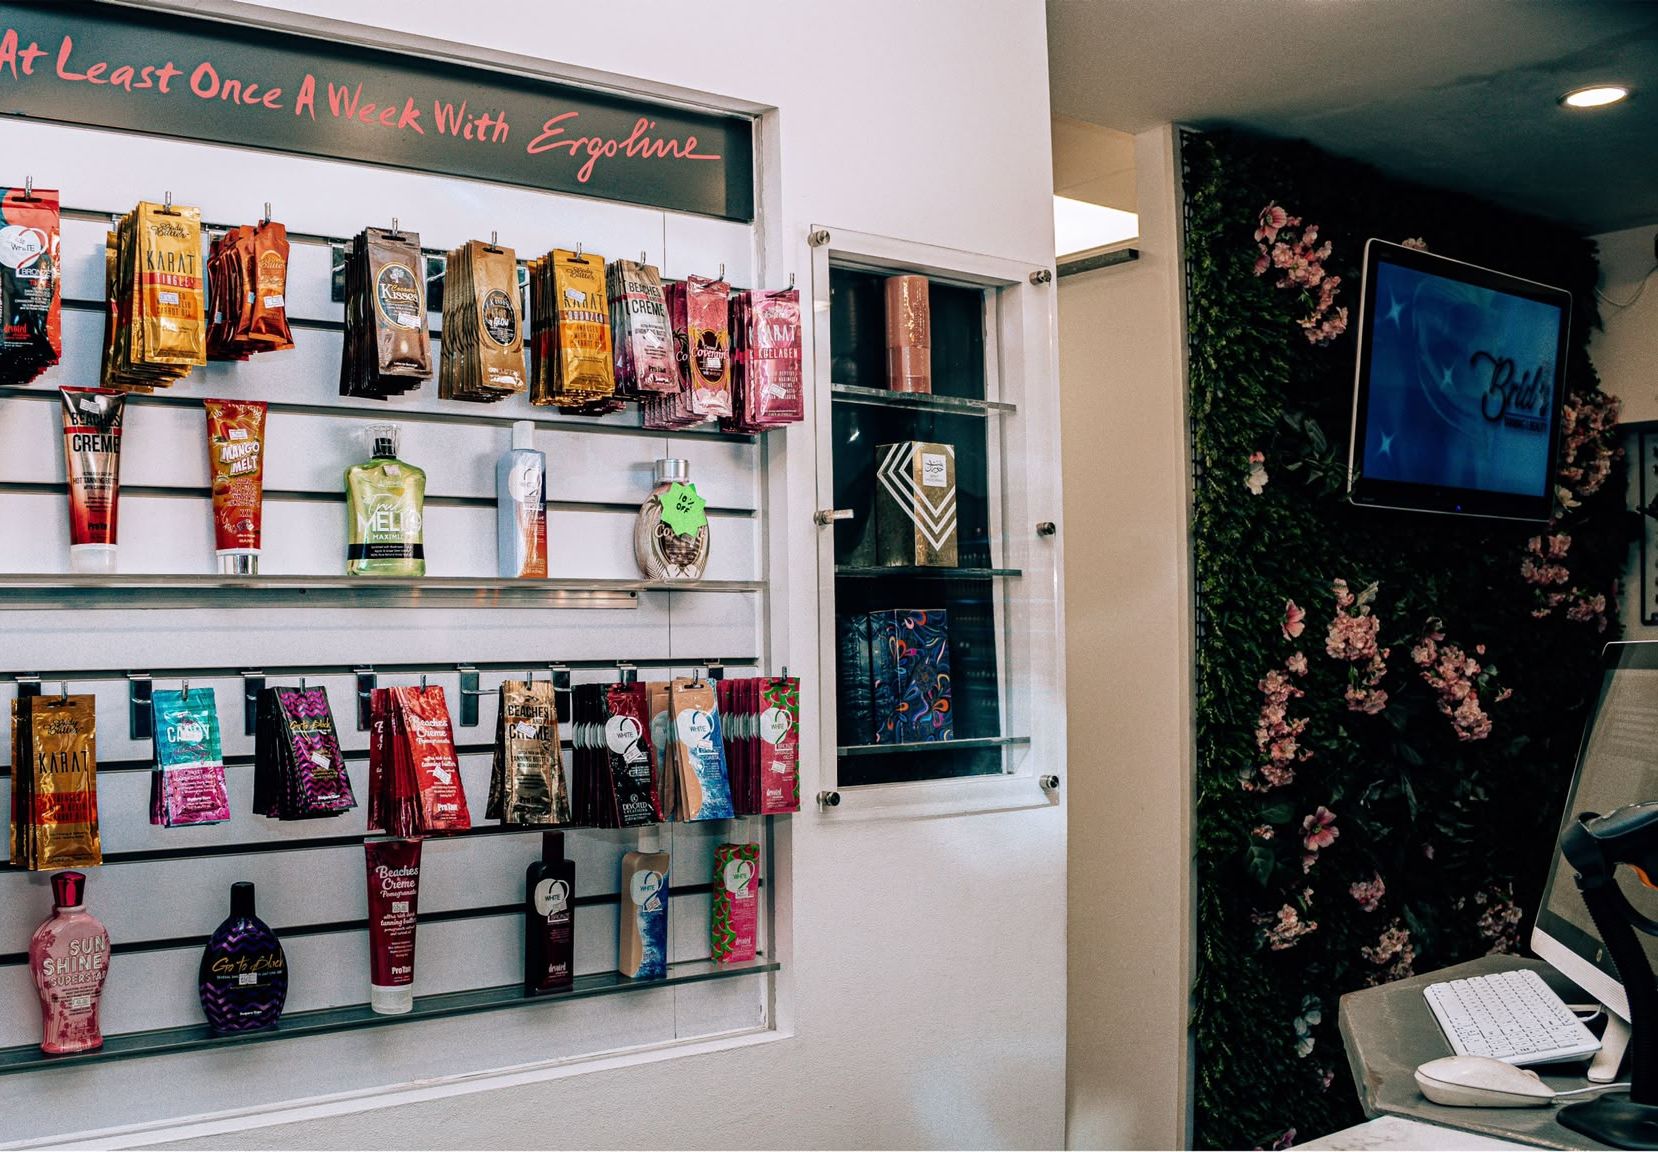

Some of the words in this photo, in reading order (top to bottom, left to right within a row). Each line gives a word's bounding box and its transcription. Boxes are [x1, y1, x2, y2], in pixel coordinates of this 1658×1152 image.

[0, 29, 46, 76] At
[56, 37, 183, 94] Least
[190, 63, 282, 109] Once
[295, 75, 316, 120] A
[328, 83, 425, 135] Week
[434, 101, 510, 143] With
[527, 111, 721, 183] Ergoline
[146, 250, 195, 274] KARAT
[628, 281, 661, 298] BEACHES
[631, 299, 665, 317] CREME
[72, 434, 120, 453] CREME
[222, 442, 260, 461] MANGO
[231, 455, 257, 475] MELT
[508, 704, 549, 718] BEACHES
[616, 731, 634, 739] WHITE
[39, 751, 88, 774] KARAT
[375, 864, 419, 879] Beaches
[70, 935, 106, 956] SUN
[43, 953, 103, 976] SHINE
